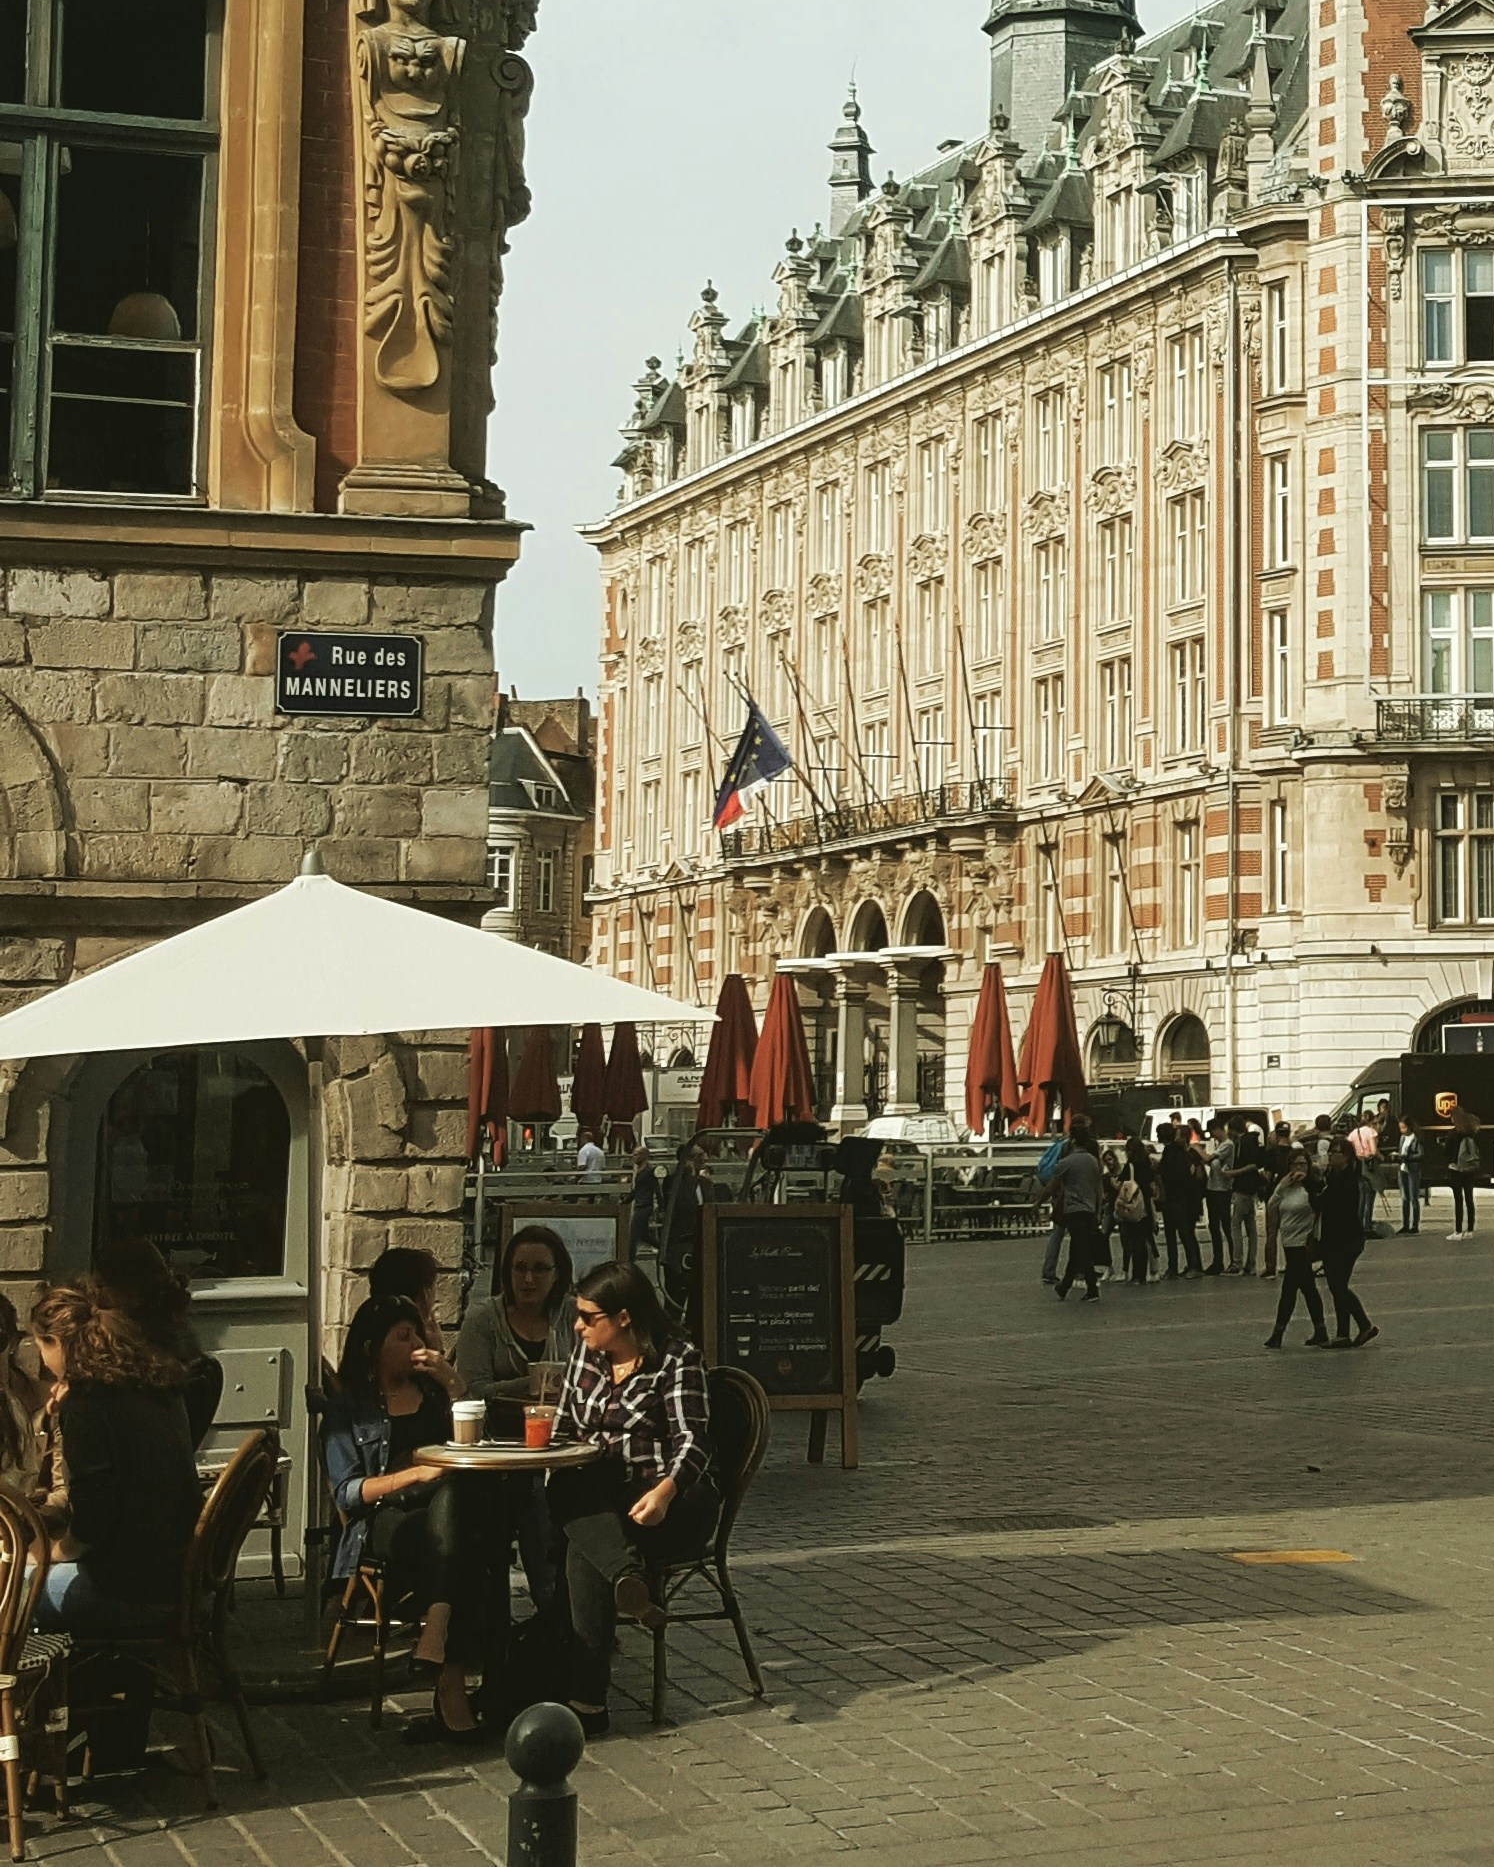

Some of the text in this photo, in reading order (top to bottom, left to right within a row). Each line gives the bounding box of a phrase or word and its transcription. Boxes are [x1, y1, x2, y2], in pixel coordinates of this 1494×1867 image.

[332, 646, 406, 666] Rue des
[286, 677, 411, 699] MANNELIERS
